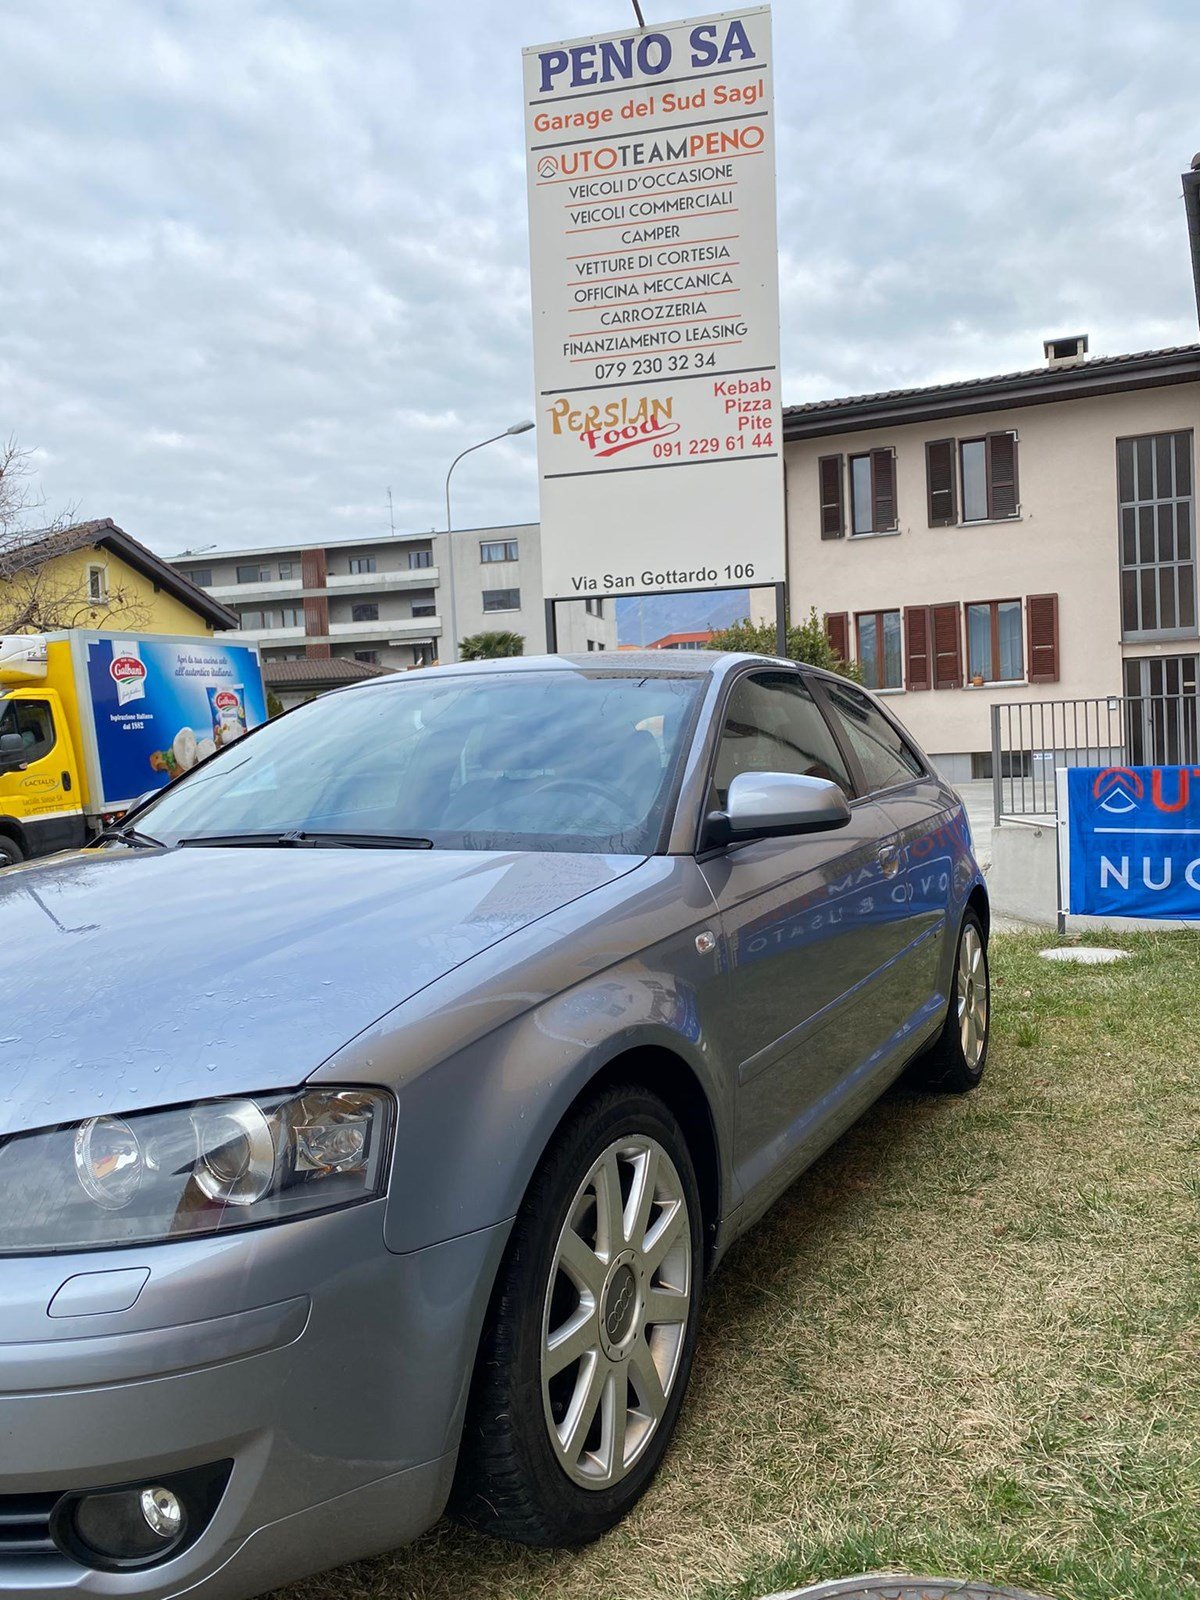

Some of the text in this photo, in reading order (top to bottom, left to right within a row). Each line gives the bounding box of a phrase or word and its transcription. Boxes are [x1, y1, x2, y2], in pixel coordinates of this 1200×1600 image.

[538, 20, 755, 92] PENO SA
[533, 79, 764, 132] Garage del Sud Sagl
[568, 164, 733, 199] VEICOLI D'OCCASIONE
[570, 190, 733, 225] VEICOLI COMMERCIALI
[621, 225, 680, 244] CAMPER
[576, 245, 730, 276] VETTURE DI CORTESIA
[574, 271, 733, 303] OFFICINA MECCANICA
[600, 301, 707, 326] CARROZZERIA
[563, 322, 748, 356] FINANZIAMENTO LEASING
[595, 351, 716, 380] 079 230 32 34
[713, 377, 771, 397] Kebab
[725, 398, 772, 414] Pizza
[579, 414, 670, 452] Food
[738, 416, 772, 431] Pite
[653, 432, 773, 458] 091 229 61 44
[571, 563, 755, 591] Via San Gottardo 106
[114, 663, 143, 676] Galbani
[24, 778, 56, 787] LACTALIS
